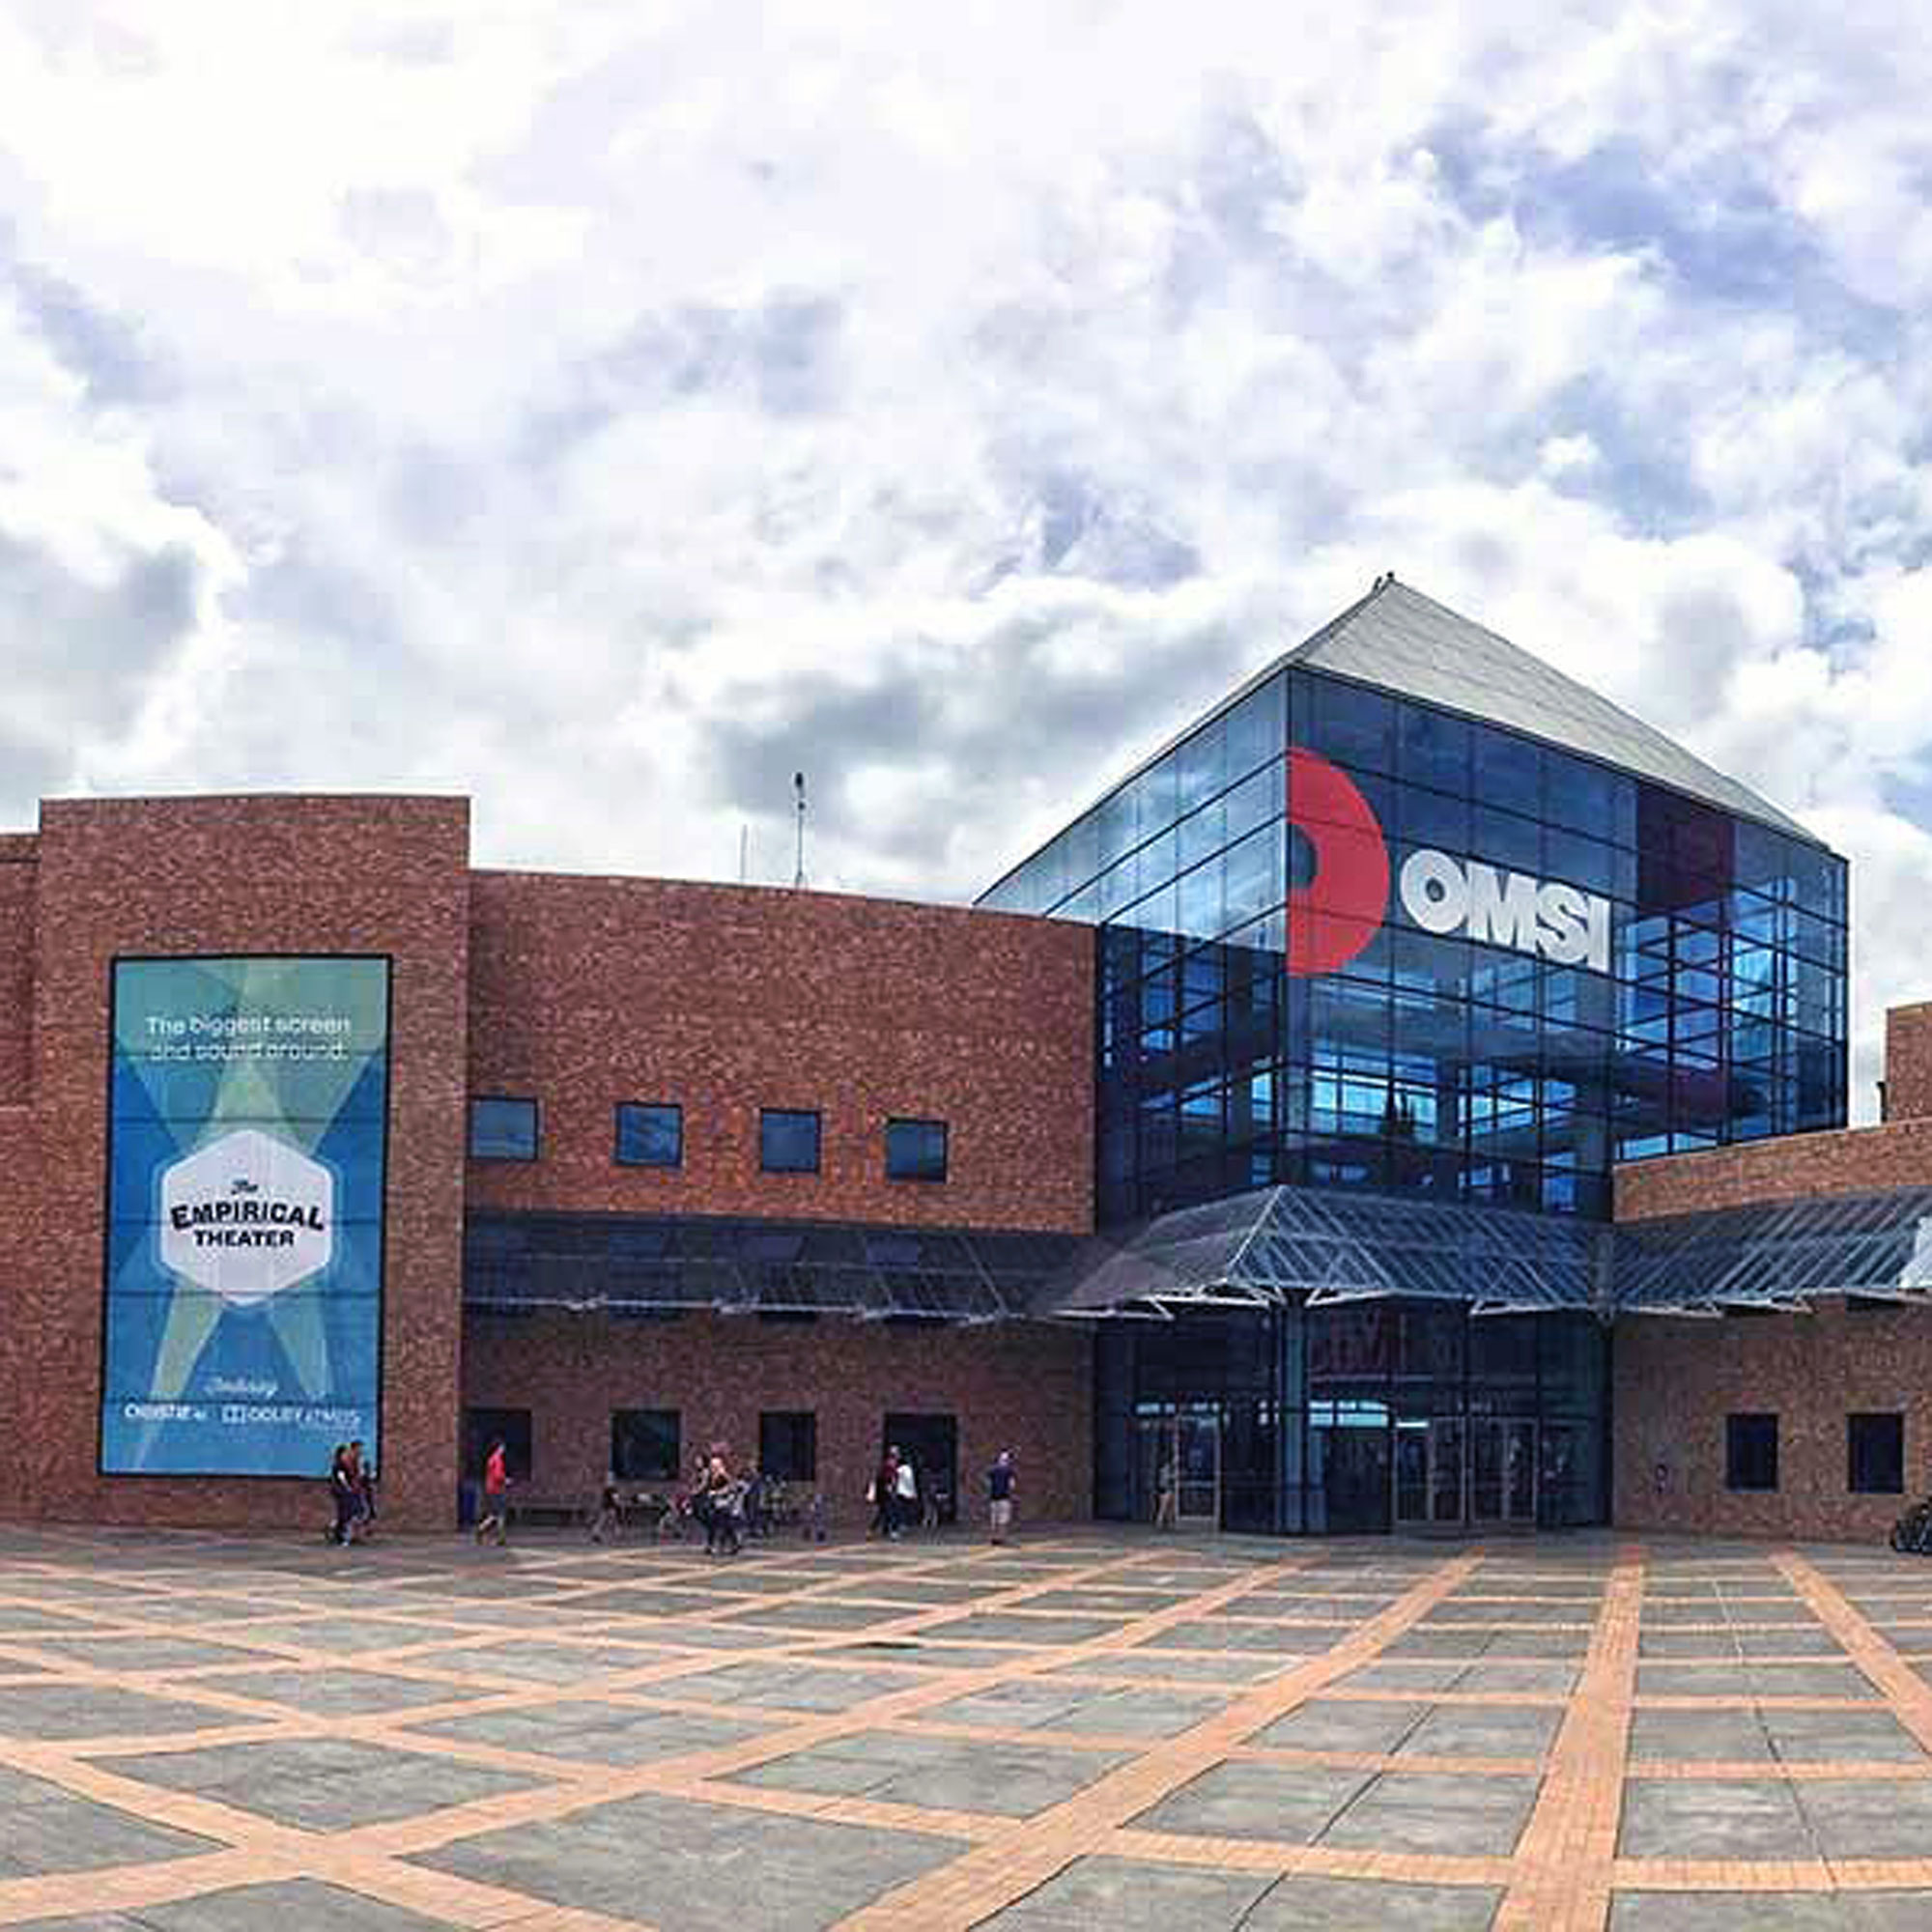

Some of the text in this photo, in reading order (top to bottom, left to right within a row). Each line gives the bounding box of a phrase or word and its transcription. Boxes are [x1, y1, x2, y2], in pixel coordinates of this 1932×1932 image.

[1401, 848, 1610, 972] OMSI
[146, 1014, 352, 1037] The biggest screen
[170, 1201, 325, 1231] EMPIRICAL
[194, 1230, 295, 1247] THEATER
